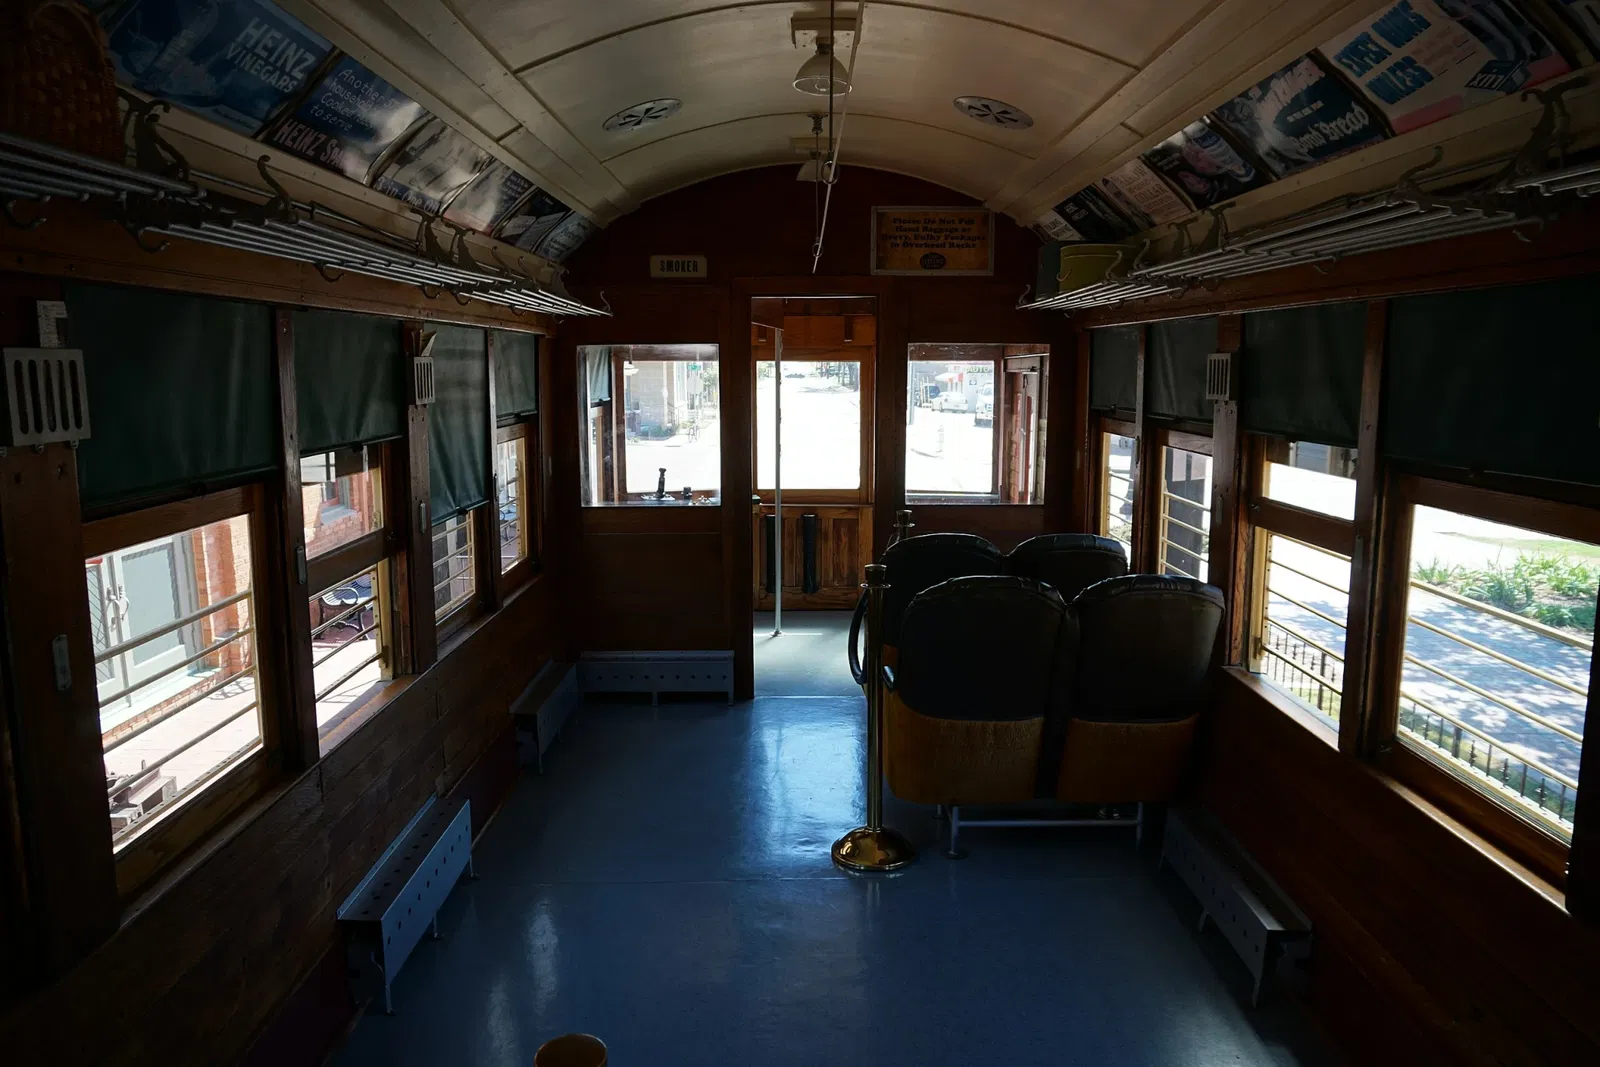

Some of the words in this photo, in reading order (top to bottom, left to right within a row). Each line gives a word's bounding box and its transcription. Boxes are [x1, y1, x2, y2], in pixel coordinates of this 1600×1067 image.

[236, 16, 316, 80] HEINZ
[227, 42, 298, 93] VINEGARS
[328, 78, 374, 111] household
[338, 69, 384, 103] Another
[310, 104, 324, 118] to
[322, 113, 353, 133] serve
[321, 92, 357, 118] Cooked
[1322, 101, 1370, 142] Bread
[273, 118, 328, 157] HEINZ
[893, 217, 921, 225] Please
[924, 217, 936, 225] Do
[939, 217, 956, 225] Not
[958, 217, 976, 225] Put
[895, 225, 920, 233] Hand
[660, 259, 699, 273] SMOKER
